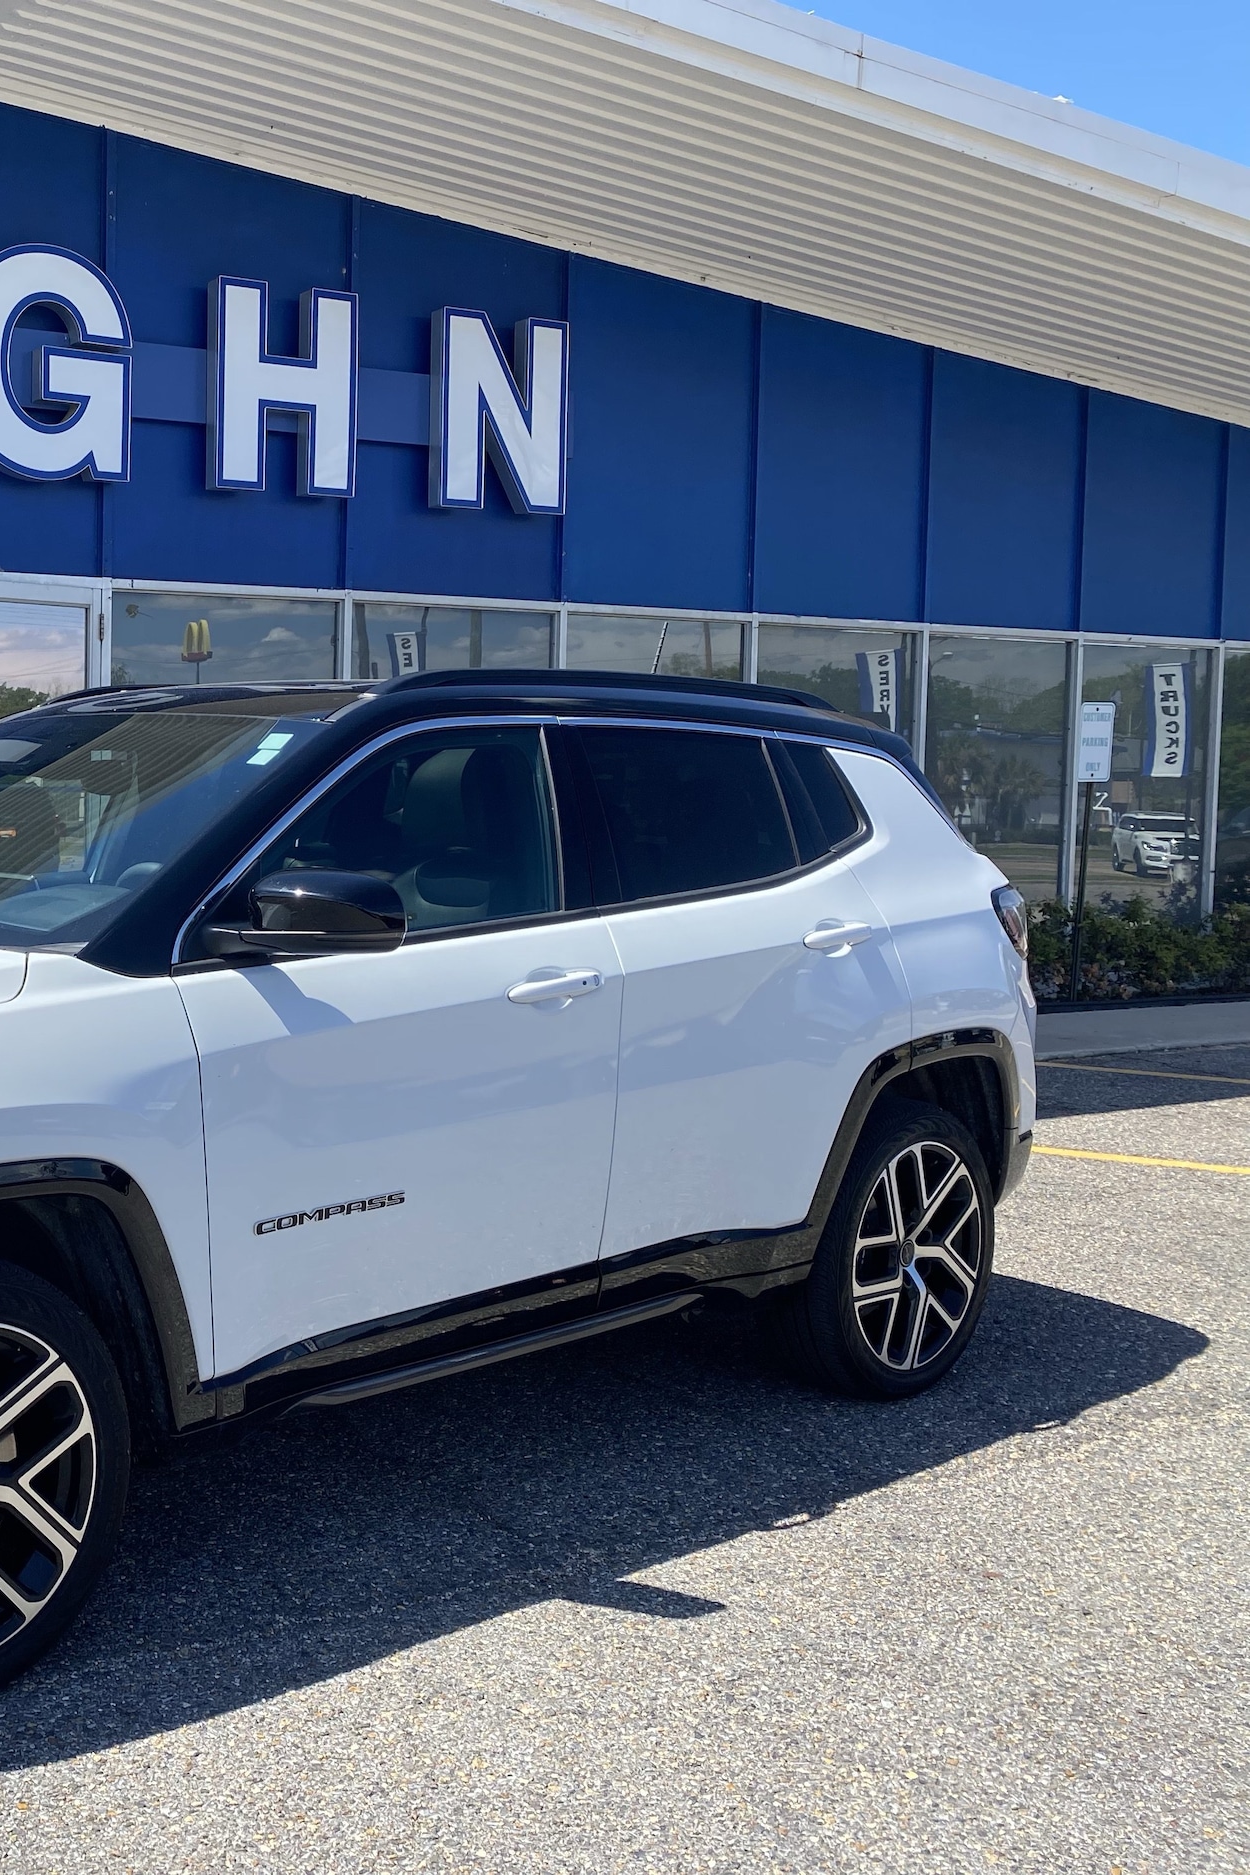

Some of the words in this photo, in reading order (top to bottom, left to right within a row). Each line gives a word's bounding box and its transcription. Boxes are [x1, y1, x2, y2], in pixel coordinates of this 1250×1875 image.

[1083, 712, 1111, 722] CUSTOMER
[1082, 737, 1109, 747] PARKING
[1085, 762, 1101, 772] ONLY
[253, 1190, 405, 1236] COMPASS
